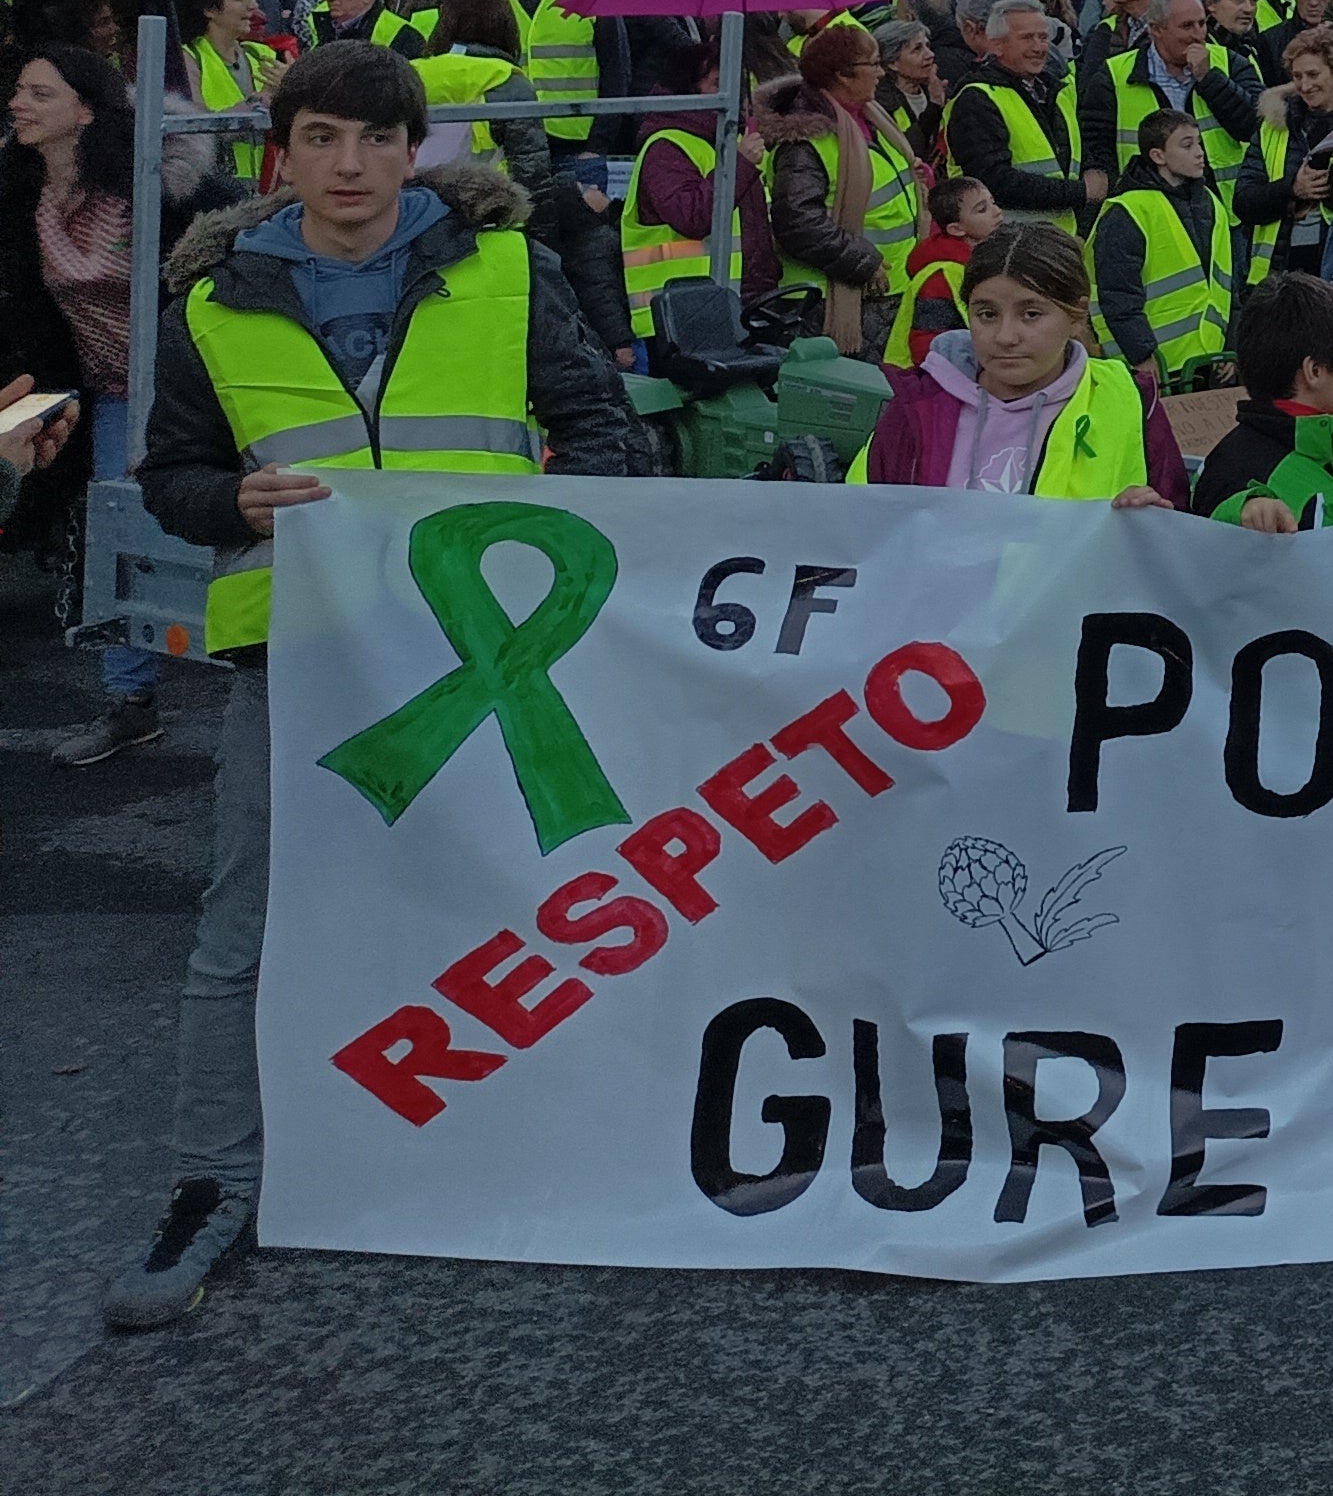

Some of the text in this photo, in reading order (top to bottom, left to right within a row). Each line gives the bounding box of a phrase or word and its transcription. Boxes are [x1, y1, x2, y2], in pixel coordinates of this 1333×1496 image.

[693, 557, 857, 655] 6F
[331, 641, 986, 1128] RESPETO
[690, 997, 1284, 1226] GURE
